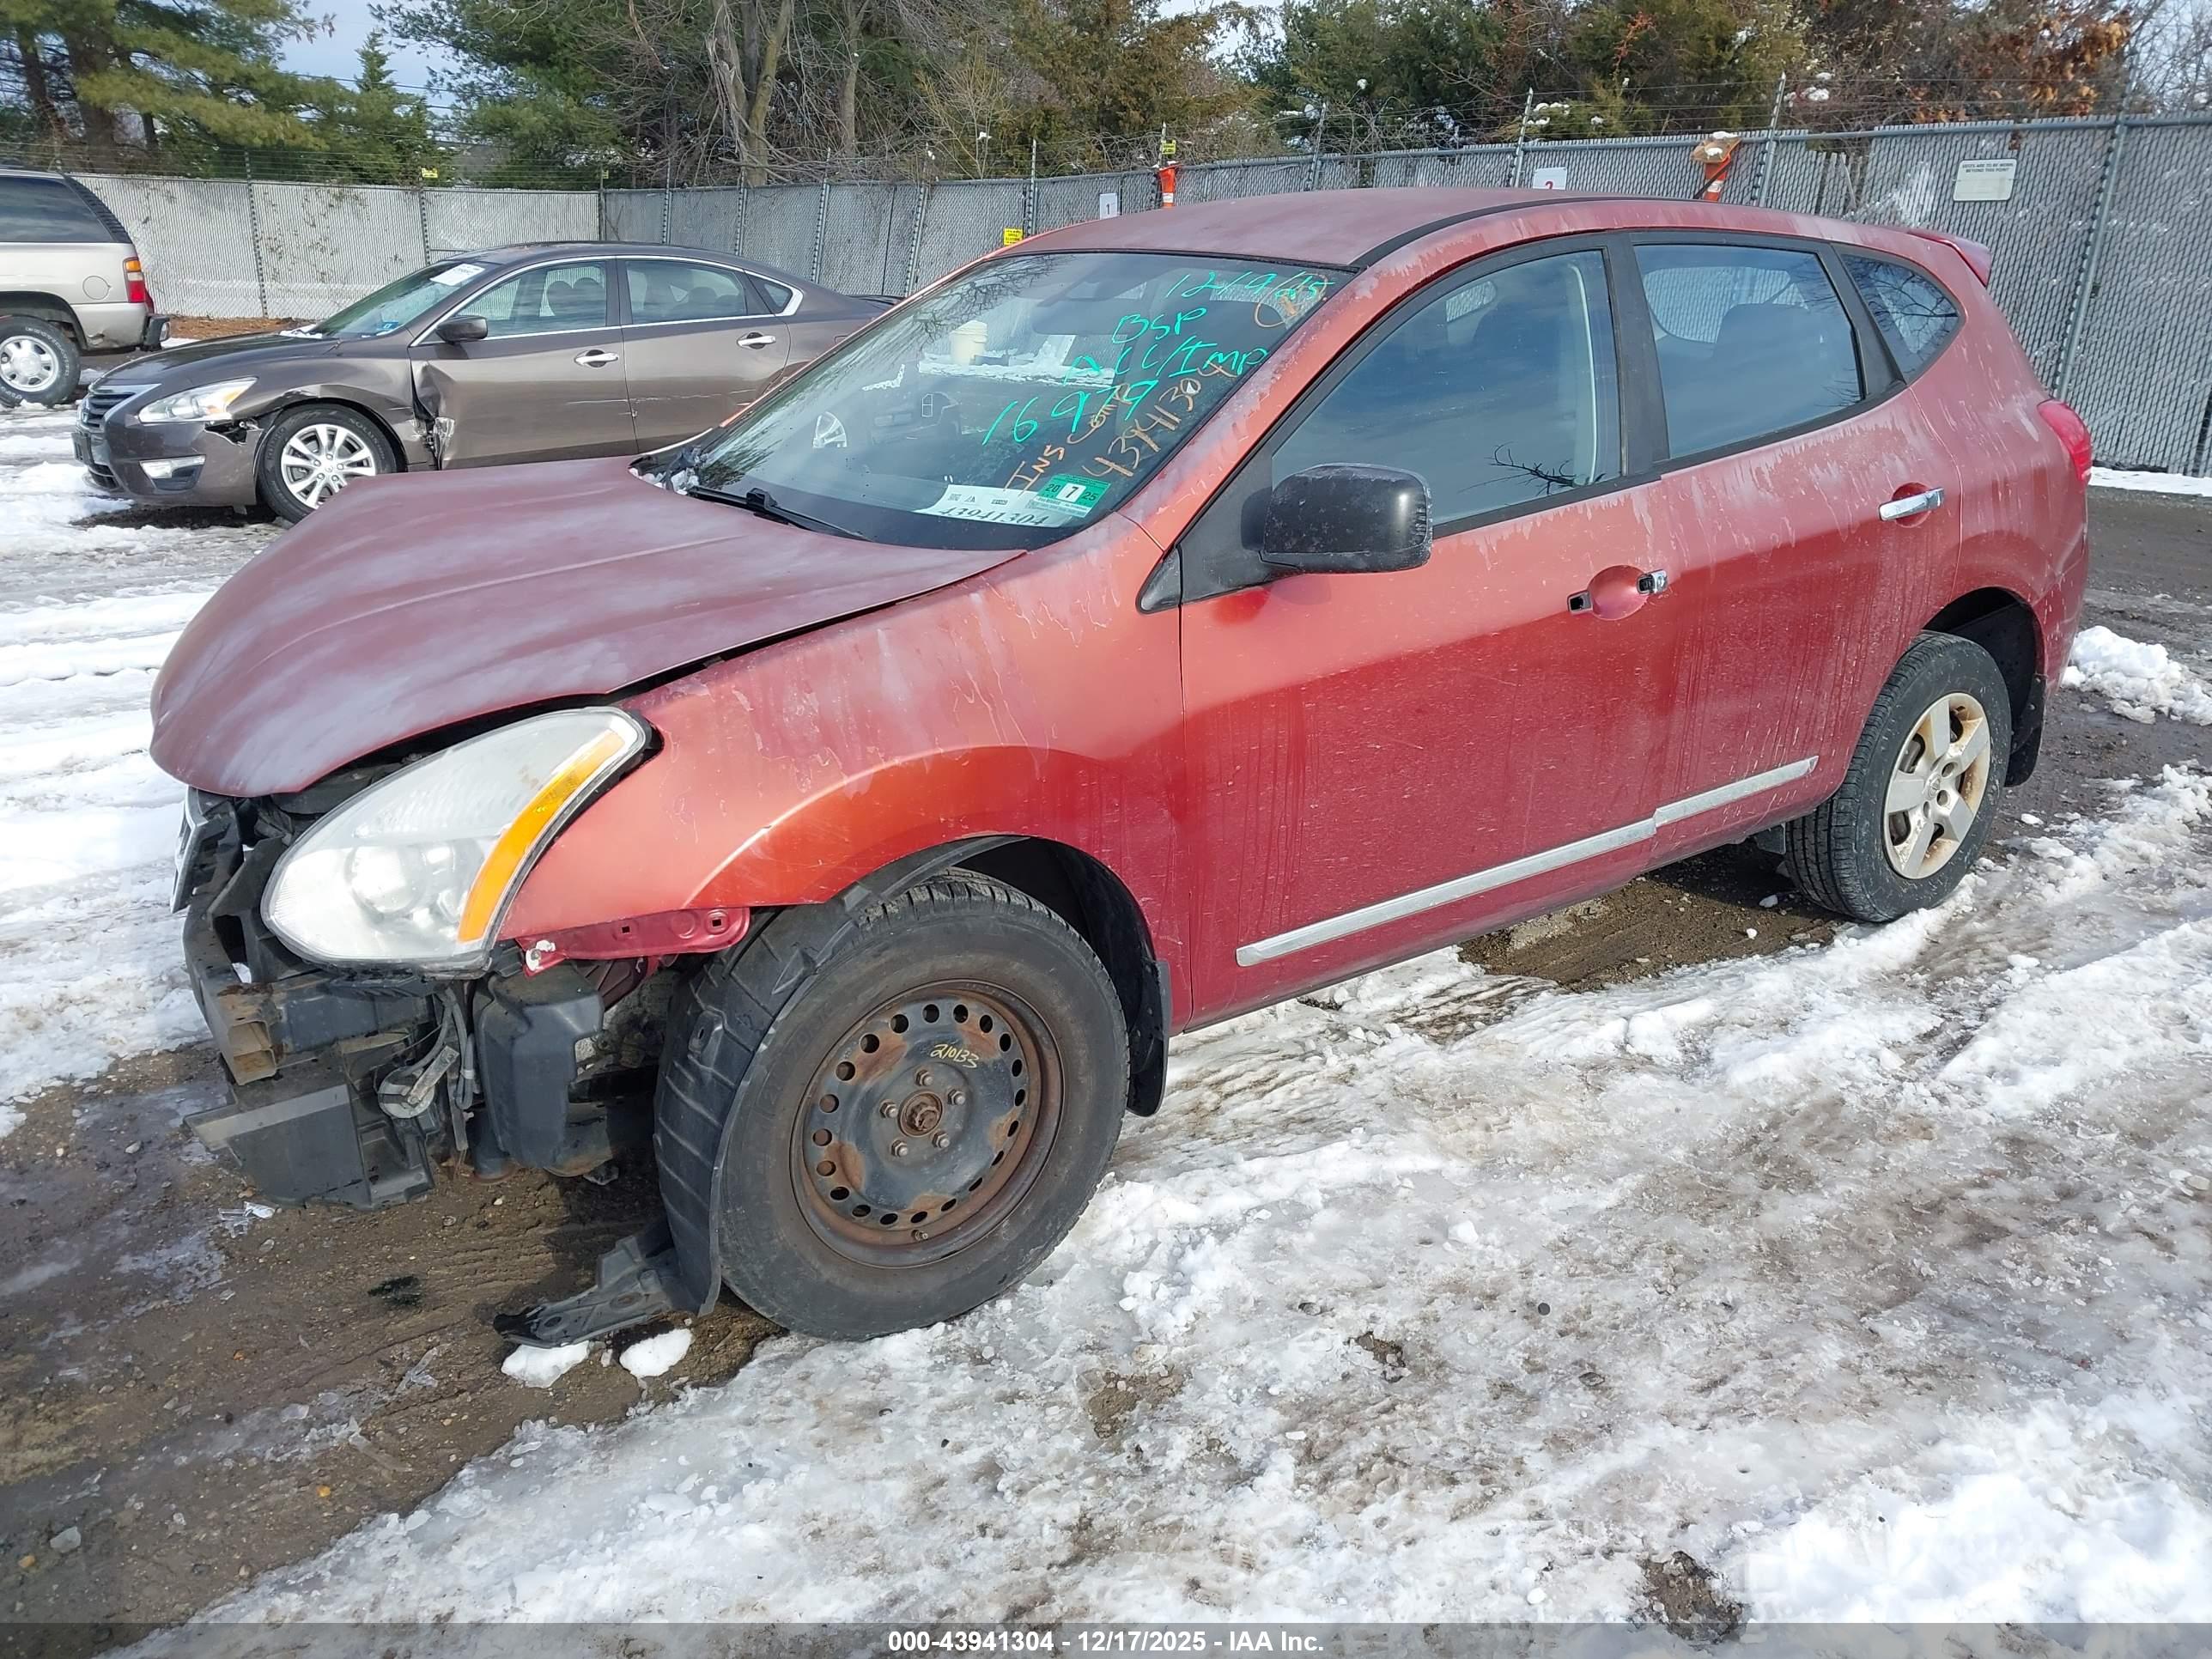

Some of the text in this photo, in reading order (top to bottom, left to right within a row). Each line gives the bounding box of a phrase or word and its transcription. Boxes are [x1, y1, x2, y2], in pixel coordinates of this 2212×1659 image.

[1105, 203, 1110, 216] 1
[982, 380, 1159, 446] 16979
[1045, 483, 1099, 501] 20 7 25
